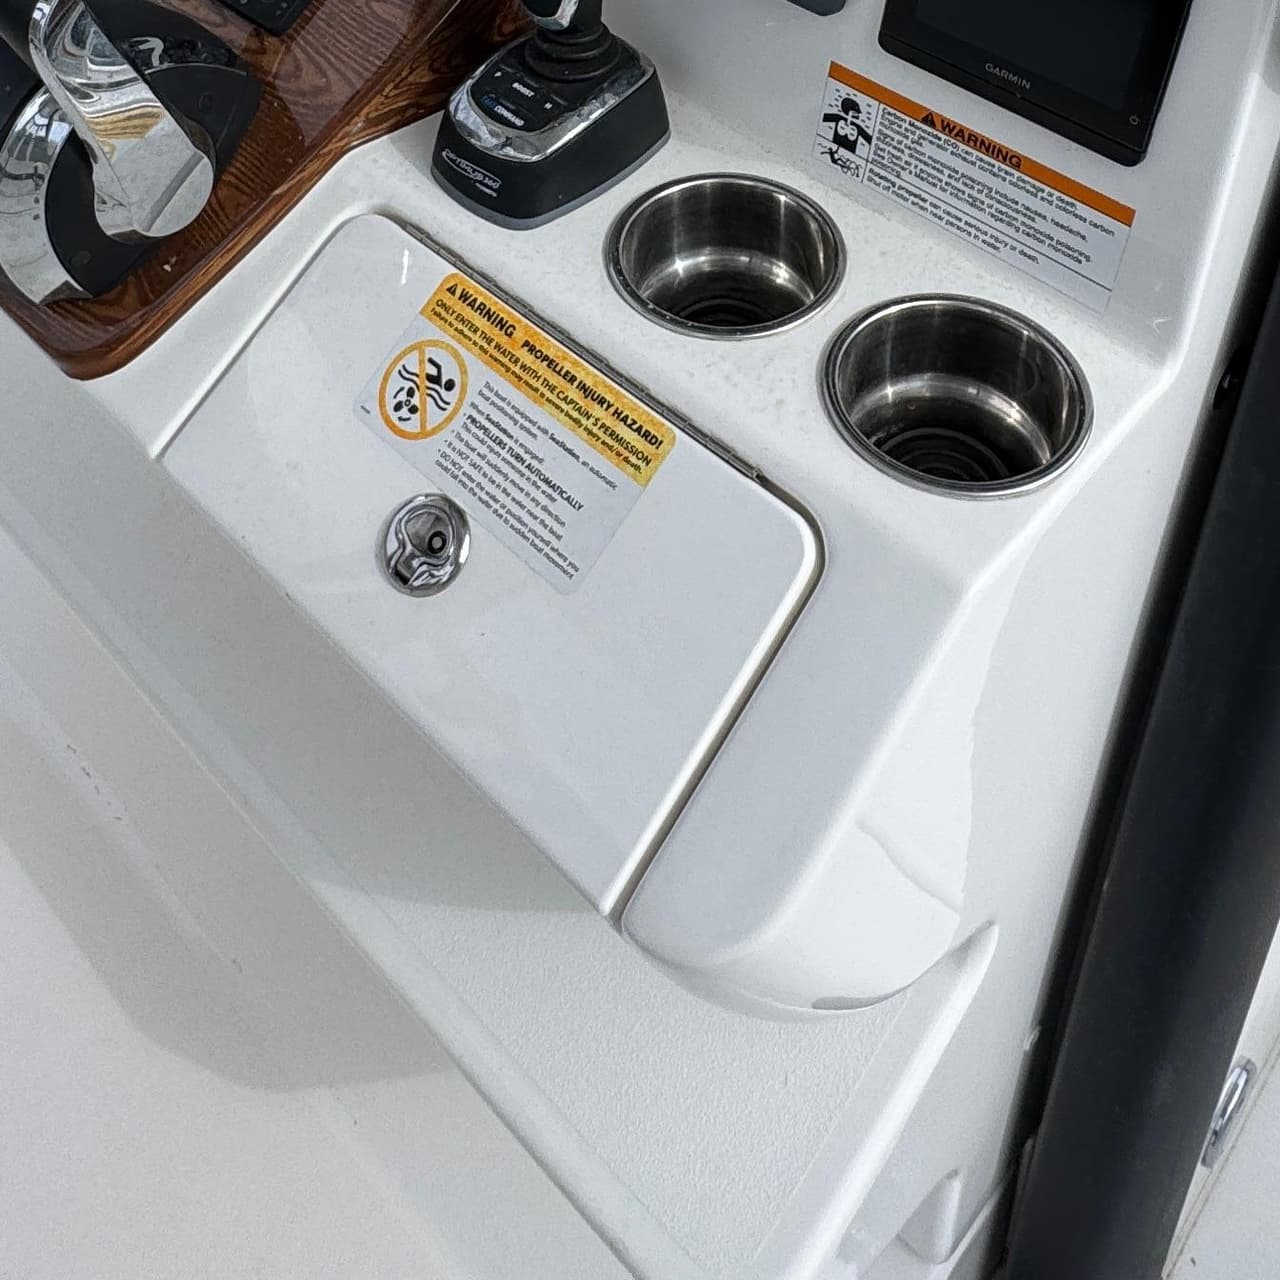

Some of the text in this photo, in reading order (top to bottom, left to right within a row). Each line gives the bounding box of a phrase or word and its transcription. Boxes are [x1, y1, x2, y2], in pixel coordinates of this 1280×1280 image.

[984, 62, 1032, 90] GARMIN
[938, 117, 1023, 170] WARNING
[434, 296, 457, 318] ONLY
[453, 311, 480, 336] ENTER
[476, 329, 495, 347] THE
[491, 340, 521, 367] WATER
[517, 360, 542, 383] WITH
[539, 376, 558, 395] THE
[597, 420, 652, 467] PERMISSION
[456, 286, 664, 451] WARNING PROPELLER INJURY HAZARD!
[465, 412, 584, 513] PROPELLERS TURN AUTOMATICALLY
